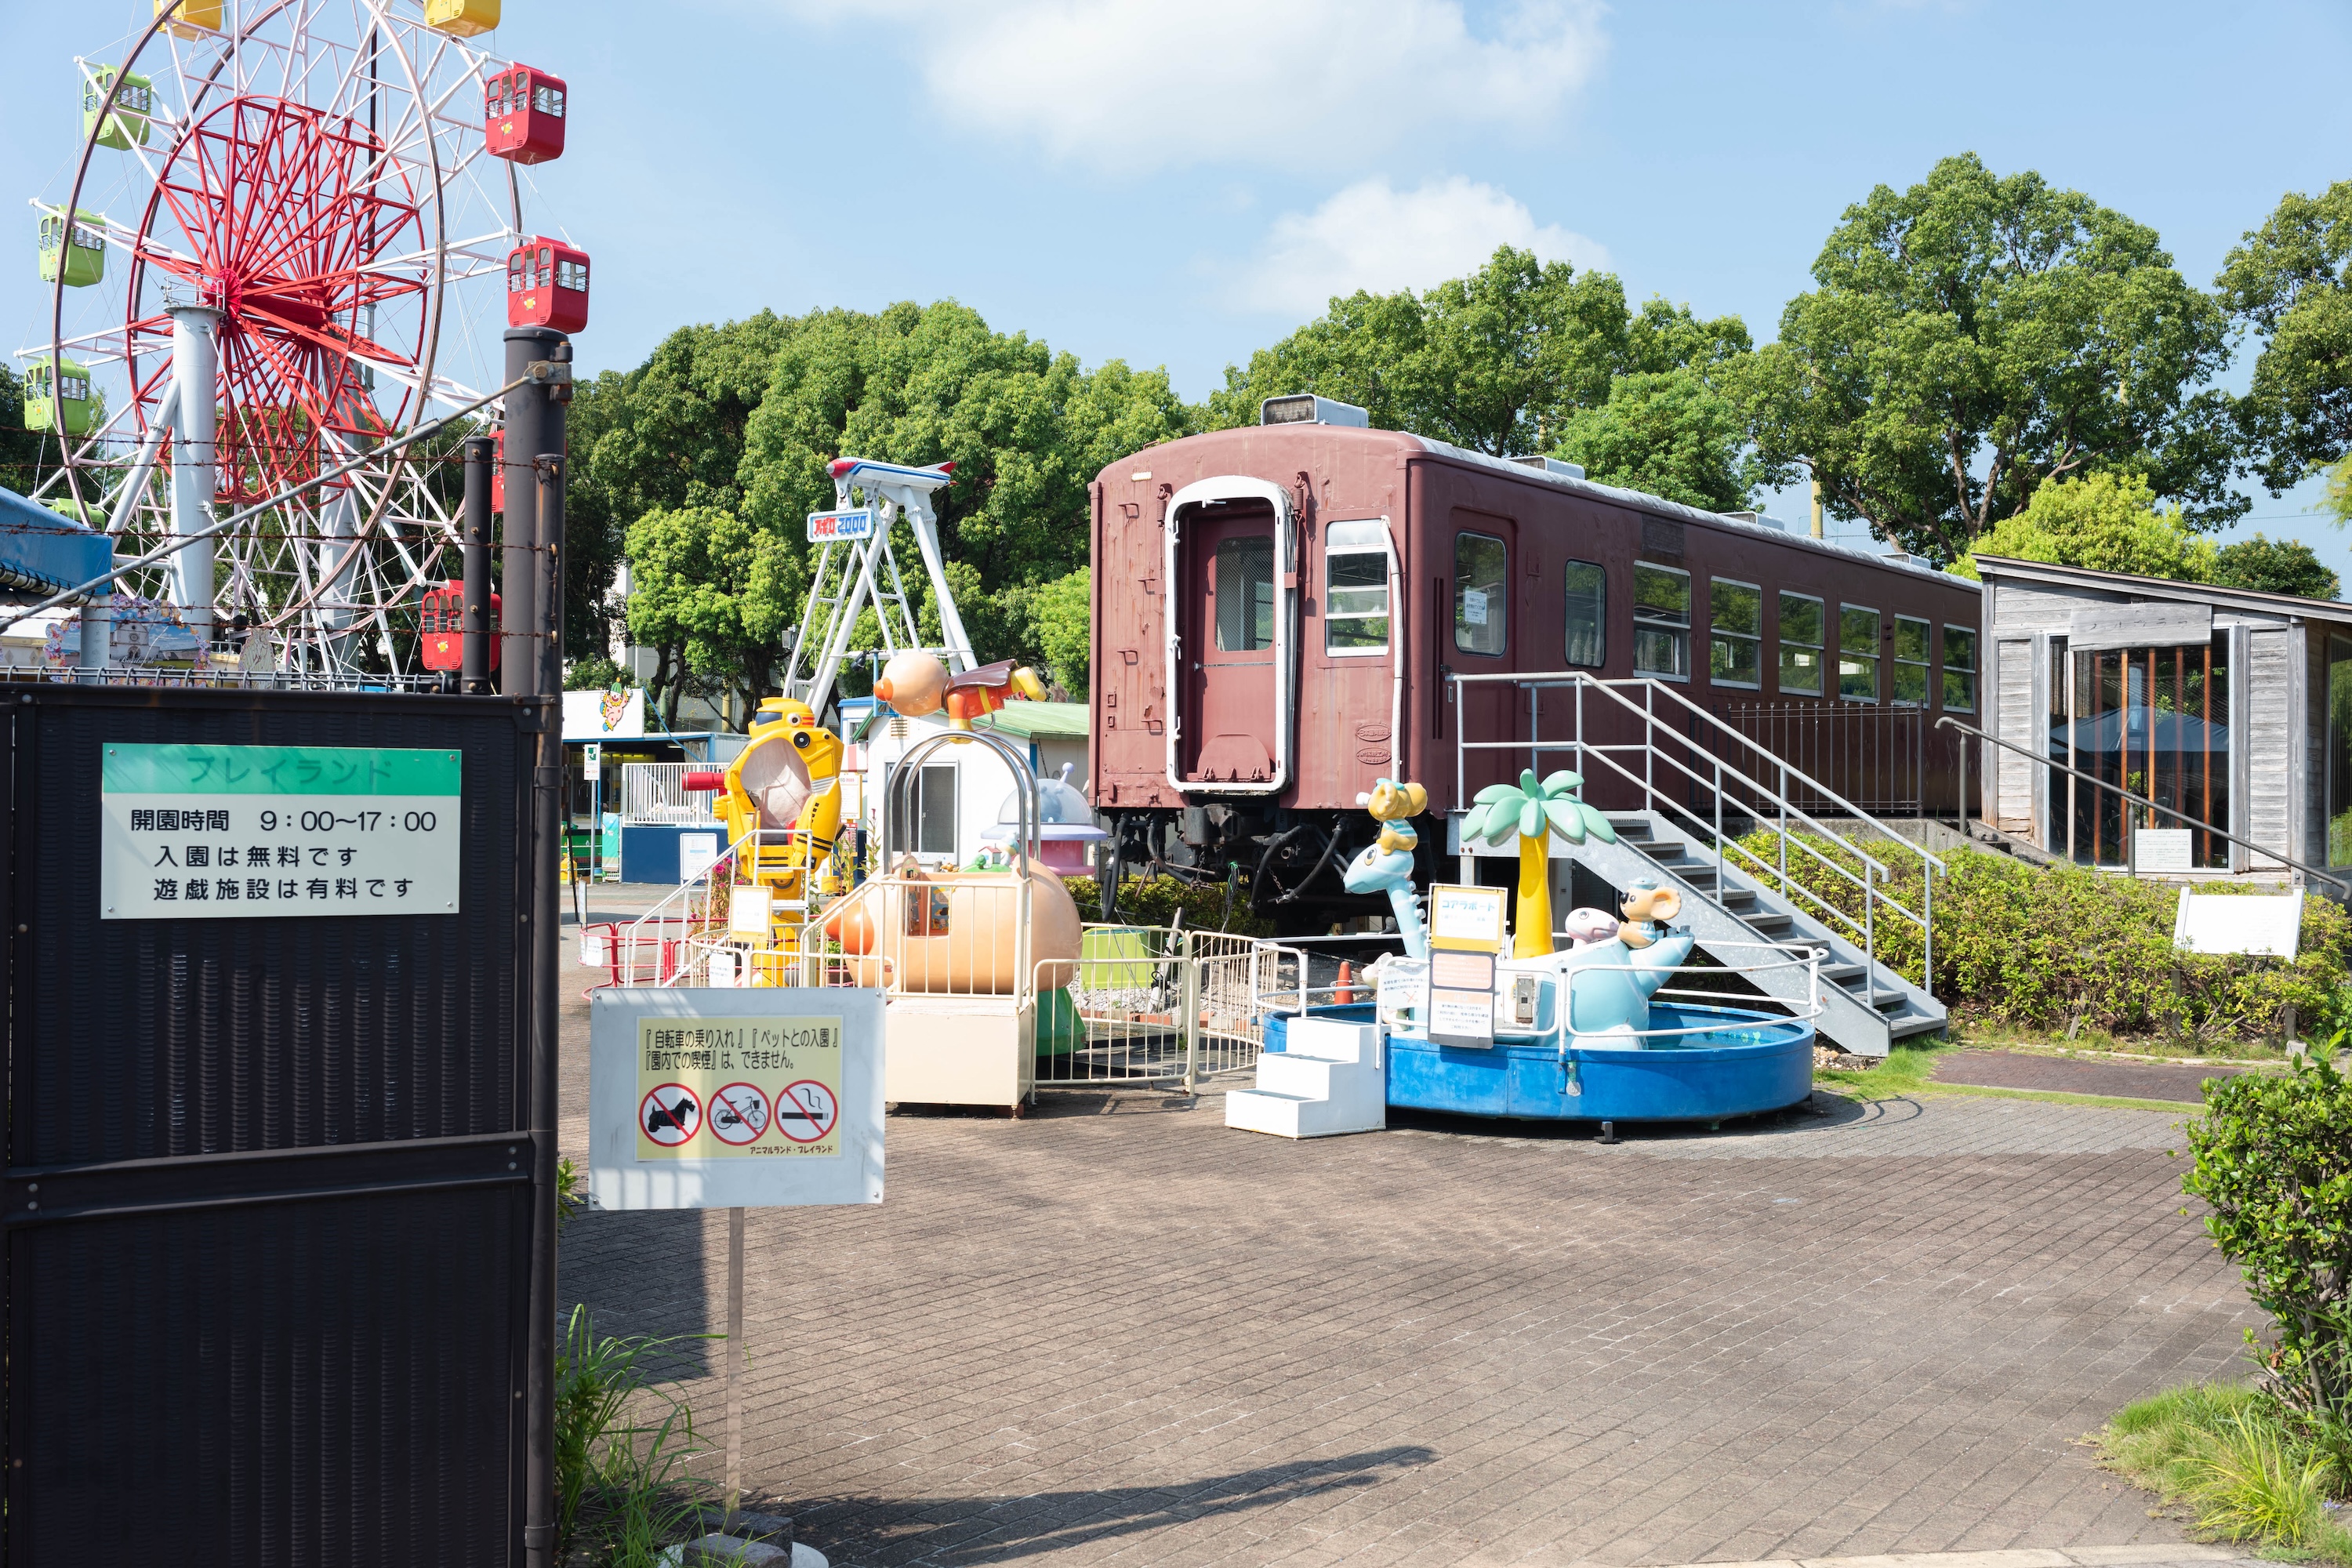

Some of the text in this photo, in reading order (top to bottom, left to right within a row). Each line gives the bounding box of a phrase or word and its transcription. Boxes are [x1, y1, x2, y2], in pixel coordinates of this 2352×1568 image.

[837, 515, 867, 533] 2000
[187, 756, 391, 784] プレイランド
[131, 810, 229, 832] 開園時間
[154, 845, 358, 868] 入園は無料です
[154, 877, 413, 901] 遊戯施設は有料です
[1442, 899, 1495, 912] コアラボート
